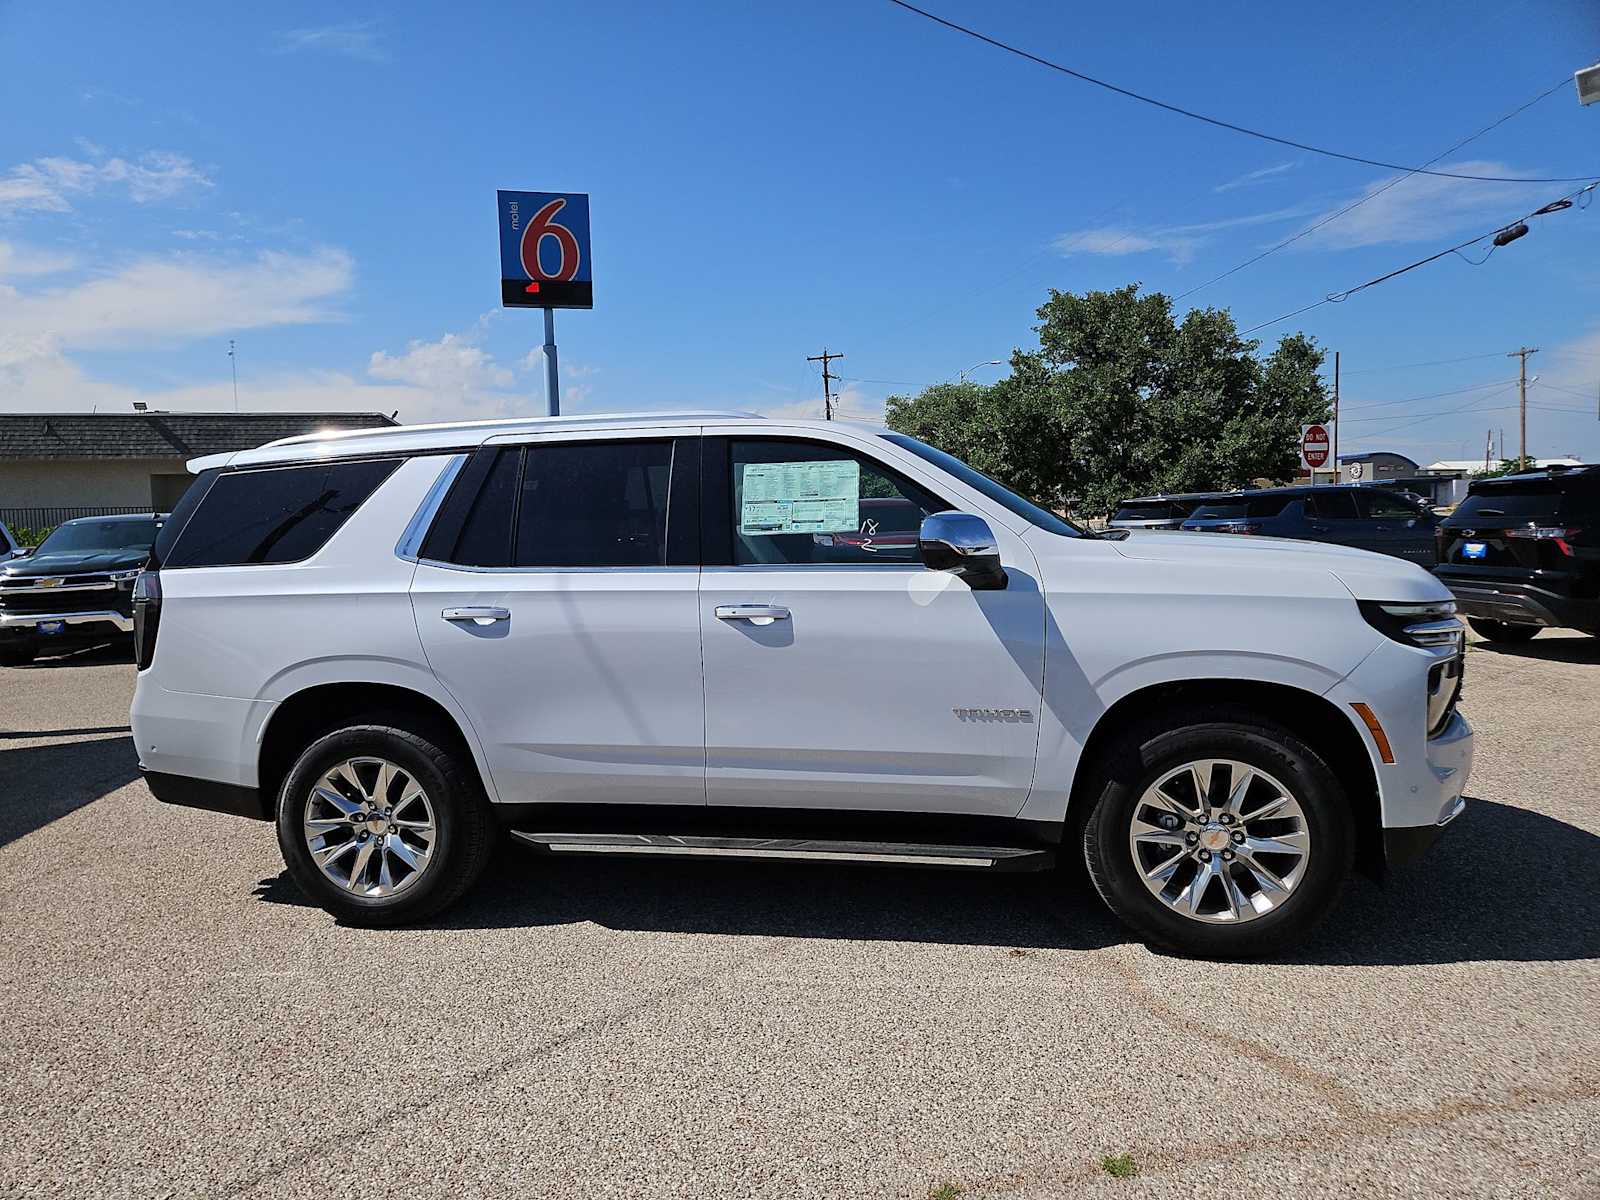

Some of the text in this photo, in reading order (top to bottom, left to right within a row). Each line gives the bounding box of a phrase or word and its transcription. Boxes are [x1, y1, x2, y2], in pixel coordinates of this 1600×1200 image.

[509, 201, 520, 230] motel
[520, 198, 580, 281] 6
[1305, 433, 1326, 441] DO NOT
[1307, 452, 1325, 460] ENTER
[860, 518, 879, 535] 18
[952, 707, 1034, 723] TAHOE
